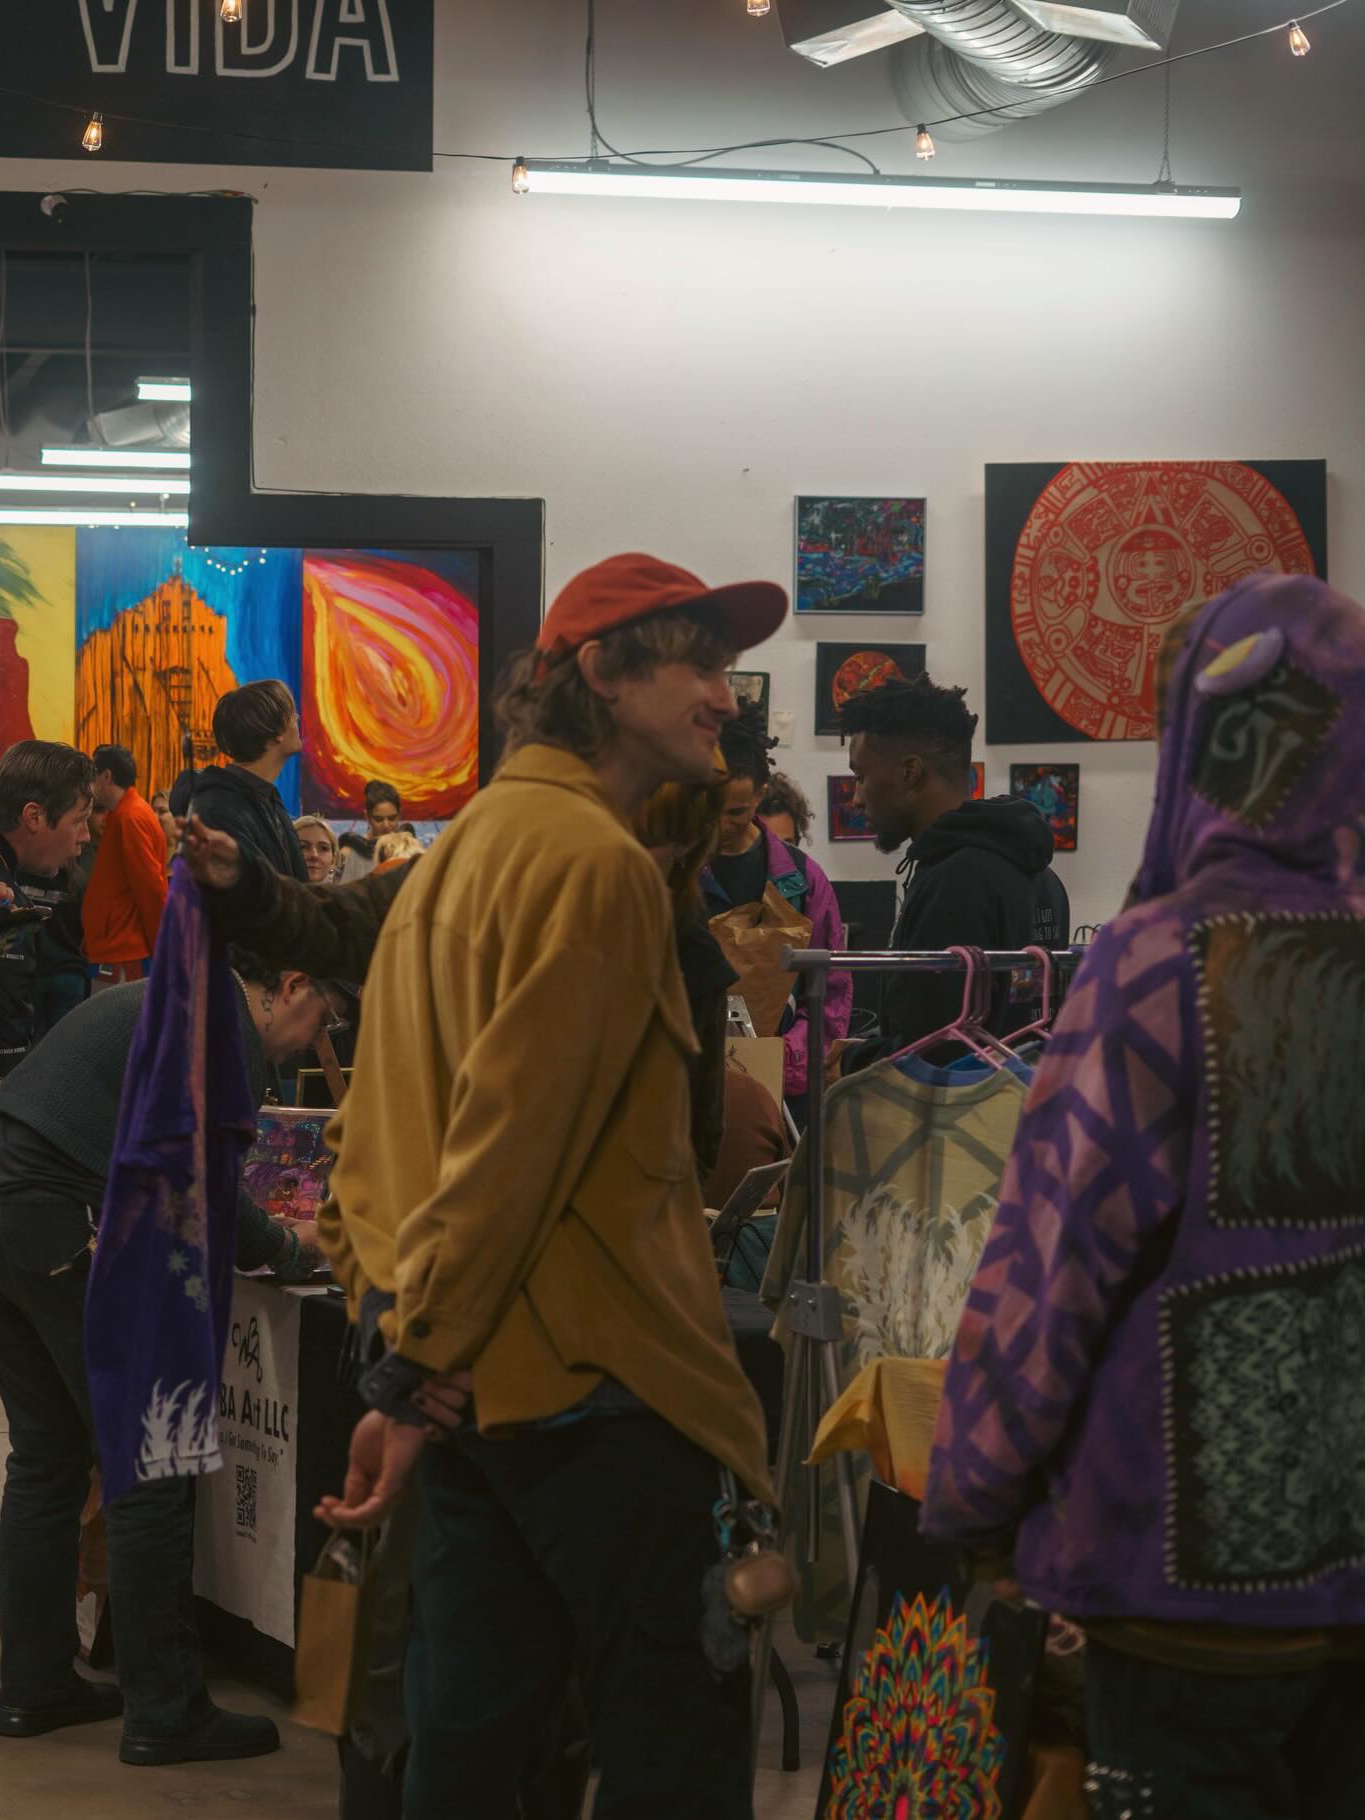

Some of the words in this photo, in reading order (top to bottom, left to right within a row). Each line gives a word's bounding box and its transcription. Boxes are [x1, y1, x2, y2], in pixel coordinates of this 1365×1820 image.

[76, 0, 401, 83] VIDA
[218, 1382, 236, 1422] BA
[240, 1389, 261, 1431] Art
[264, 1398, 289, 1442] LLC
